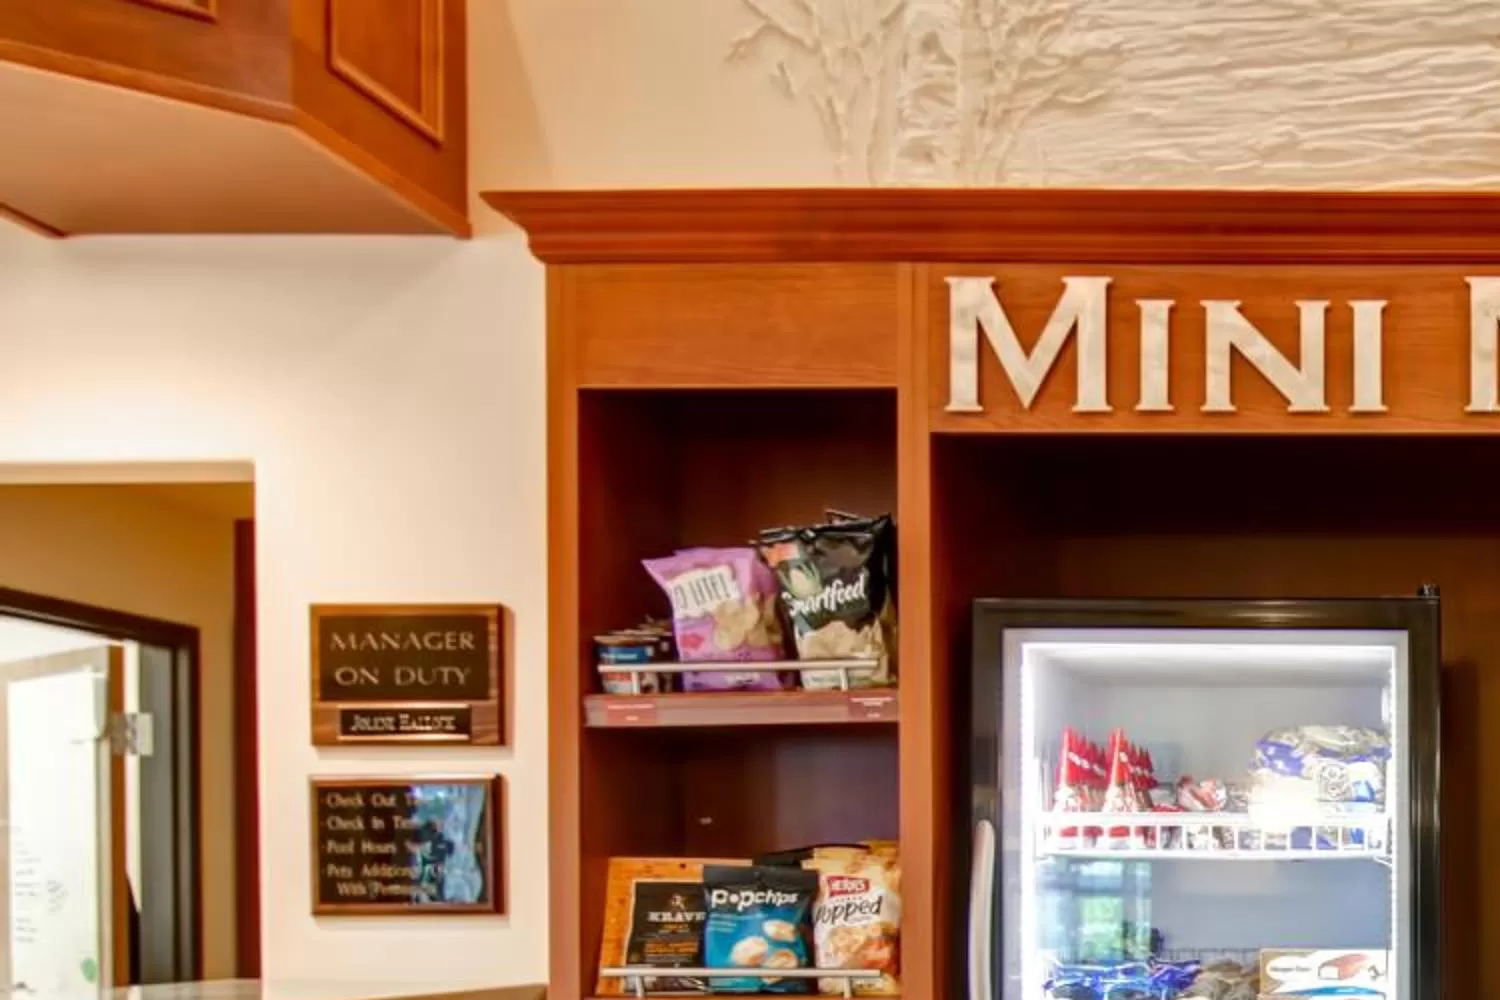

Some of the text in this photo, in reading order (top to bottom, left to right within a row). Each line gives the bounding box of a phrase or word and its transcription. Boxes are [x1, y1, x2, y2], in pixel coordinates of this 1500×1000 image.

[943, 275, 1389, 414] MINI
[329, 631, 476, 651] MANAGER
[334, 666, 471, 686] ON DUTY
